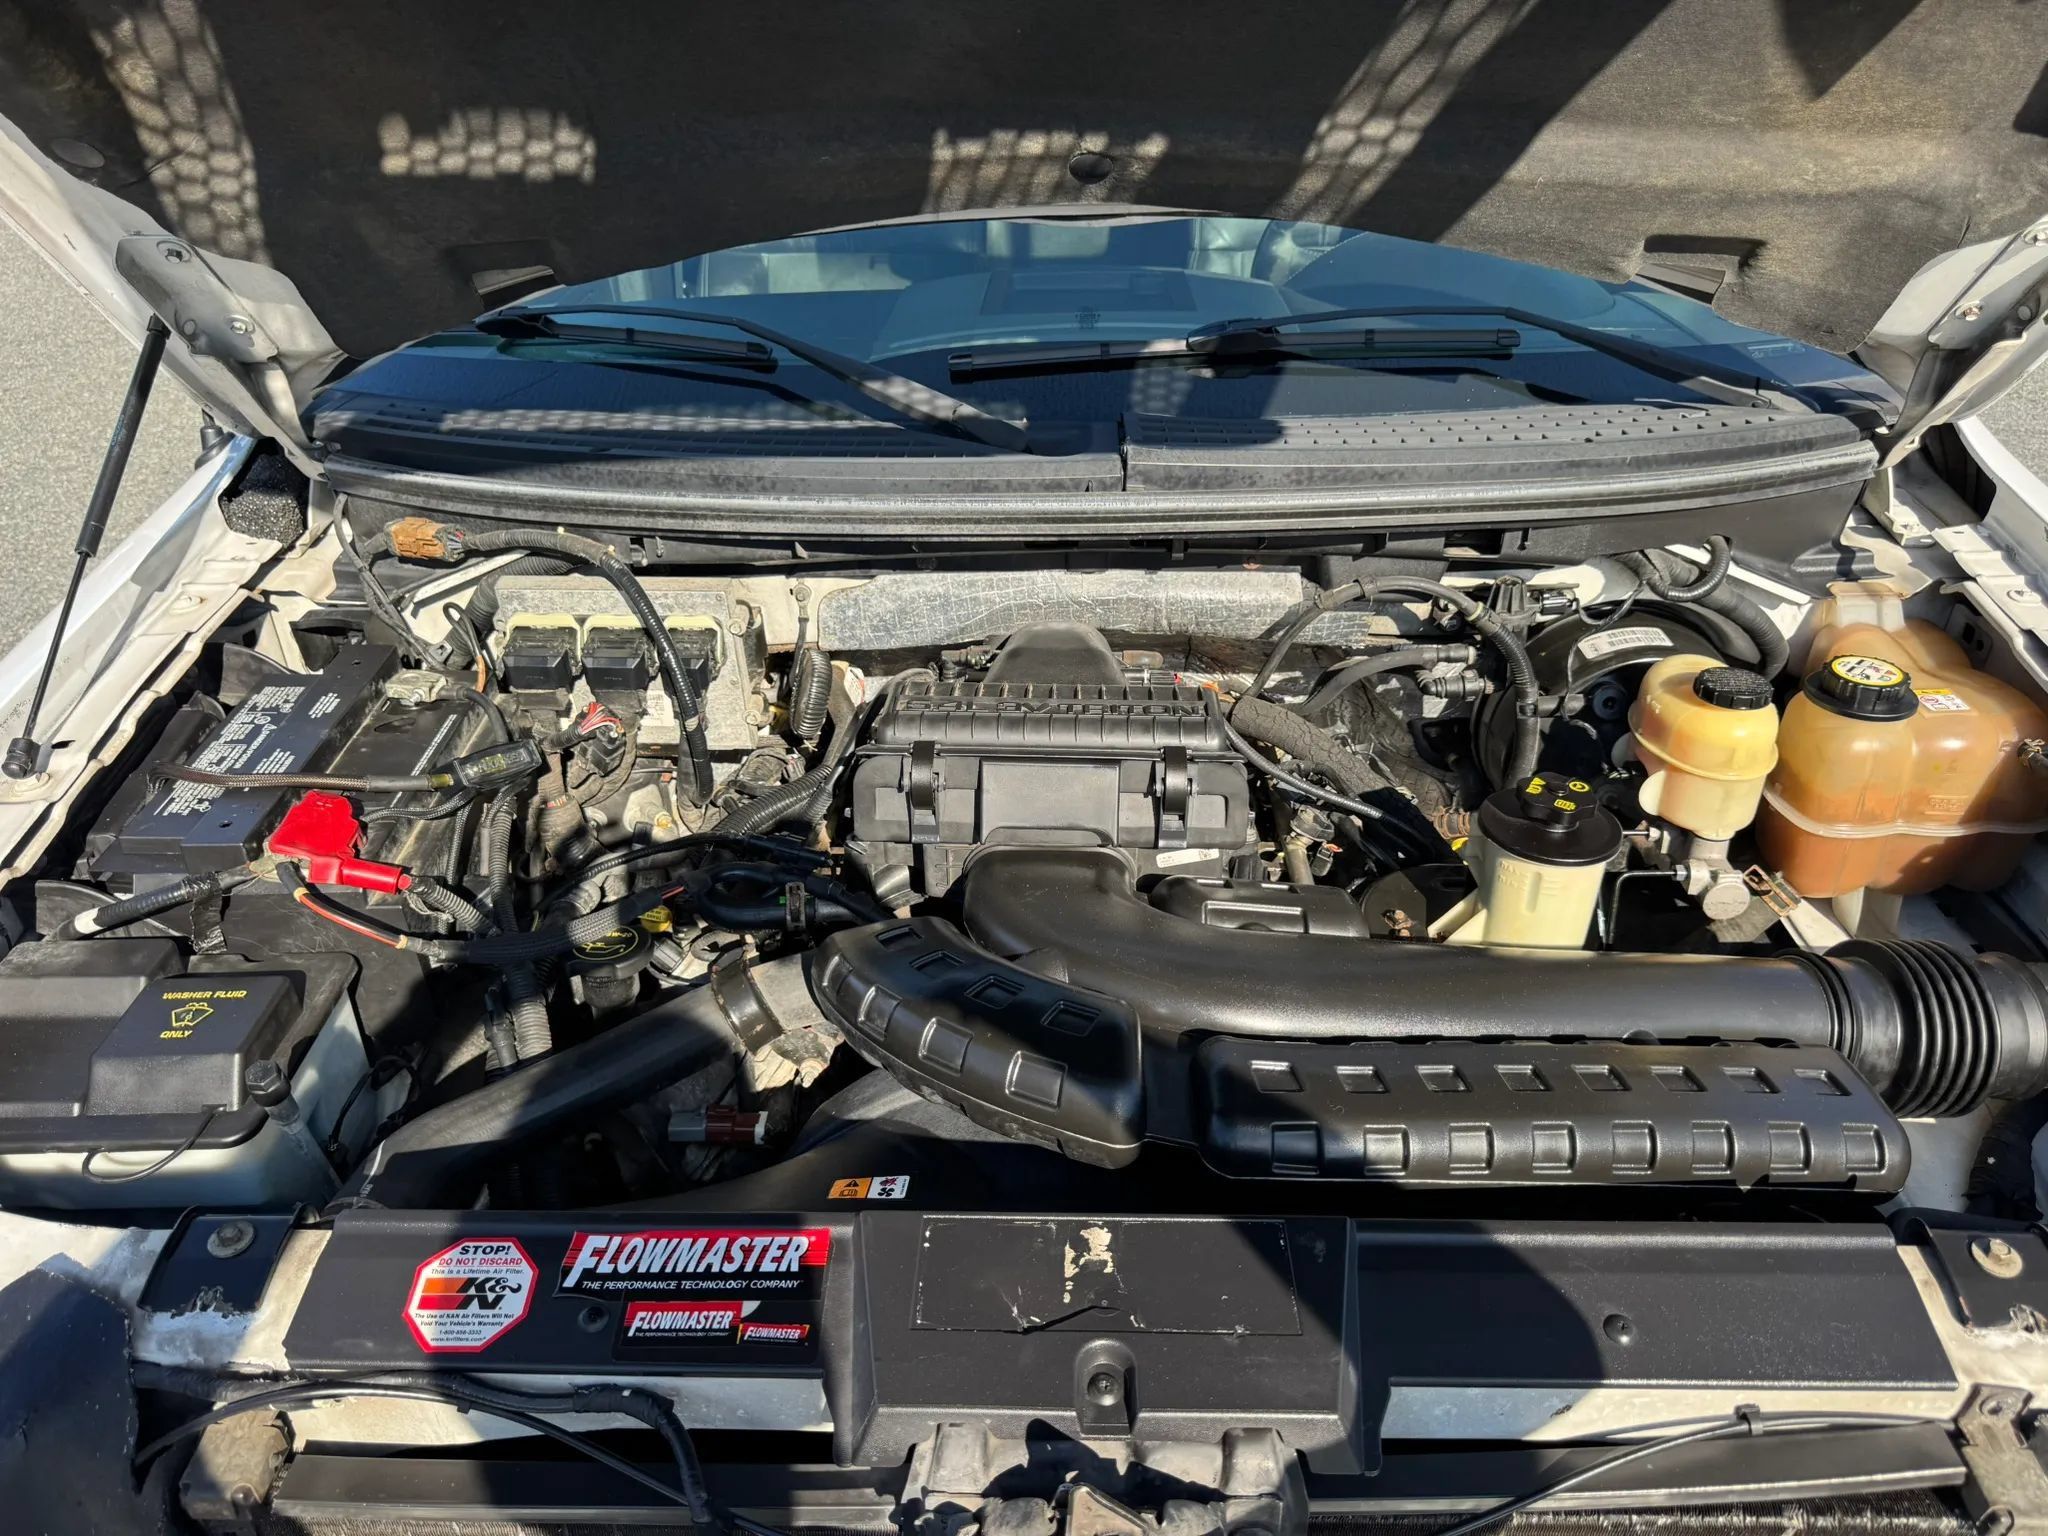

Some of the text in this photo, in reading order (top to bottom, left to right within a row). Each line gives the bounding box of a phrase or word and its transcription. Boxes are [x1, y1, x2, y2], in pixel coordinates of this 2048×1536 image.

[1057, 703, 1204, 716] TRITON
[162, 990, 248, 1000] WASHER FLUID
[160, 1030, 193, 1038] ONLY
[459, 1245, 512, 1256] STOP!
[438, 1257, 523, 1266] DO NOT DISCARD
[562, 1235, 810, 1287] FLOWMASTER
[582, 1279, 800, 1290] THE PERFORMANCE TECHNOLOGY COMPANY
[627, 1311, 734, 1337] FLOWMASTER
[743, 1326, 801, 1340] FLOWMASTER
